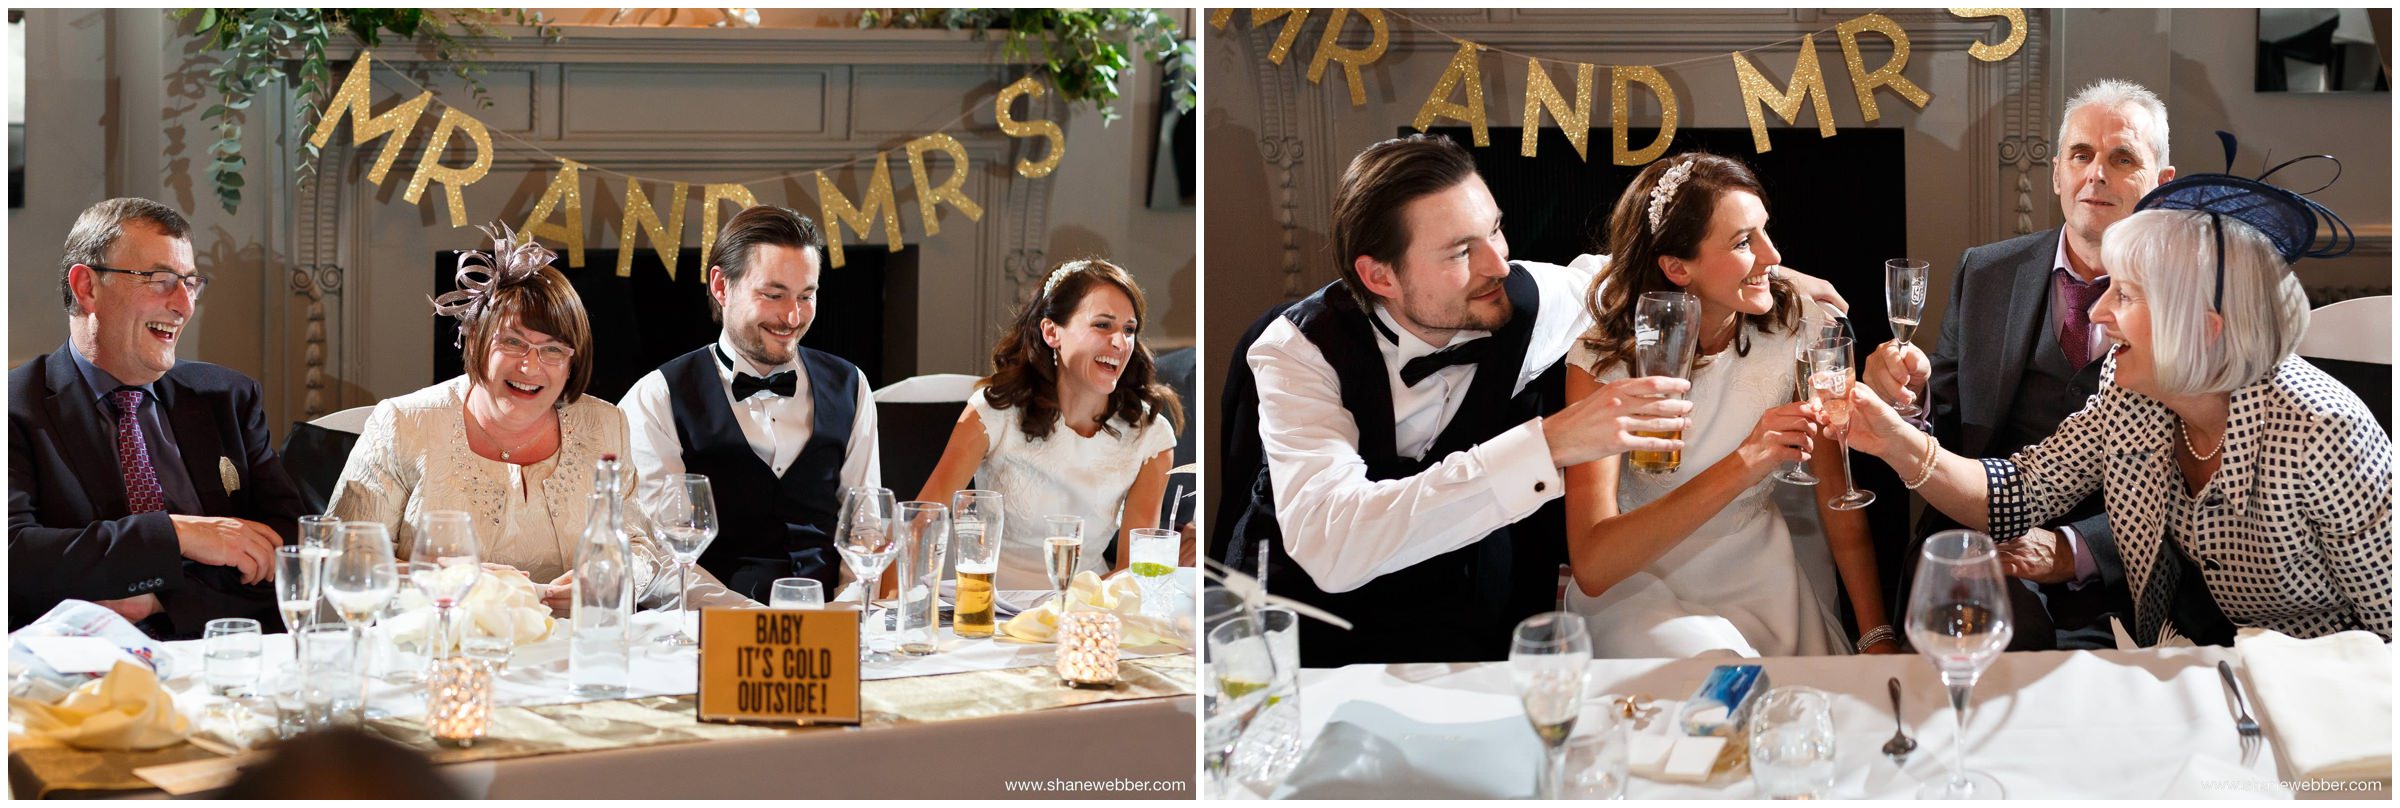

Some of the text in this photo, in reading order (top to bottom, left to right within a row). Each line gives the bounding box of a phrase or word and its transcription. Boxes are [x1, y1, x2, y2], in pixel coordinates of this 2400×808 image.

[1412, 39, 1679, 166] AND
[309, 50, 494, 228] MR
[756, 614, 803, 645] BABY
[737, 647, 831, 679] IT'S COLD
[738, 680, 828, 715] OUTSIDE!
